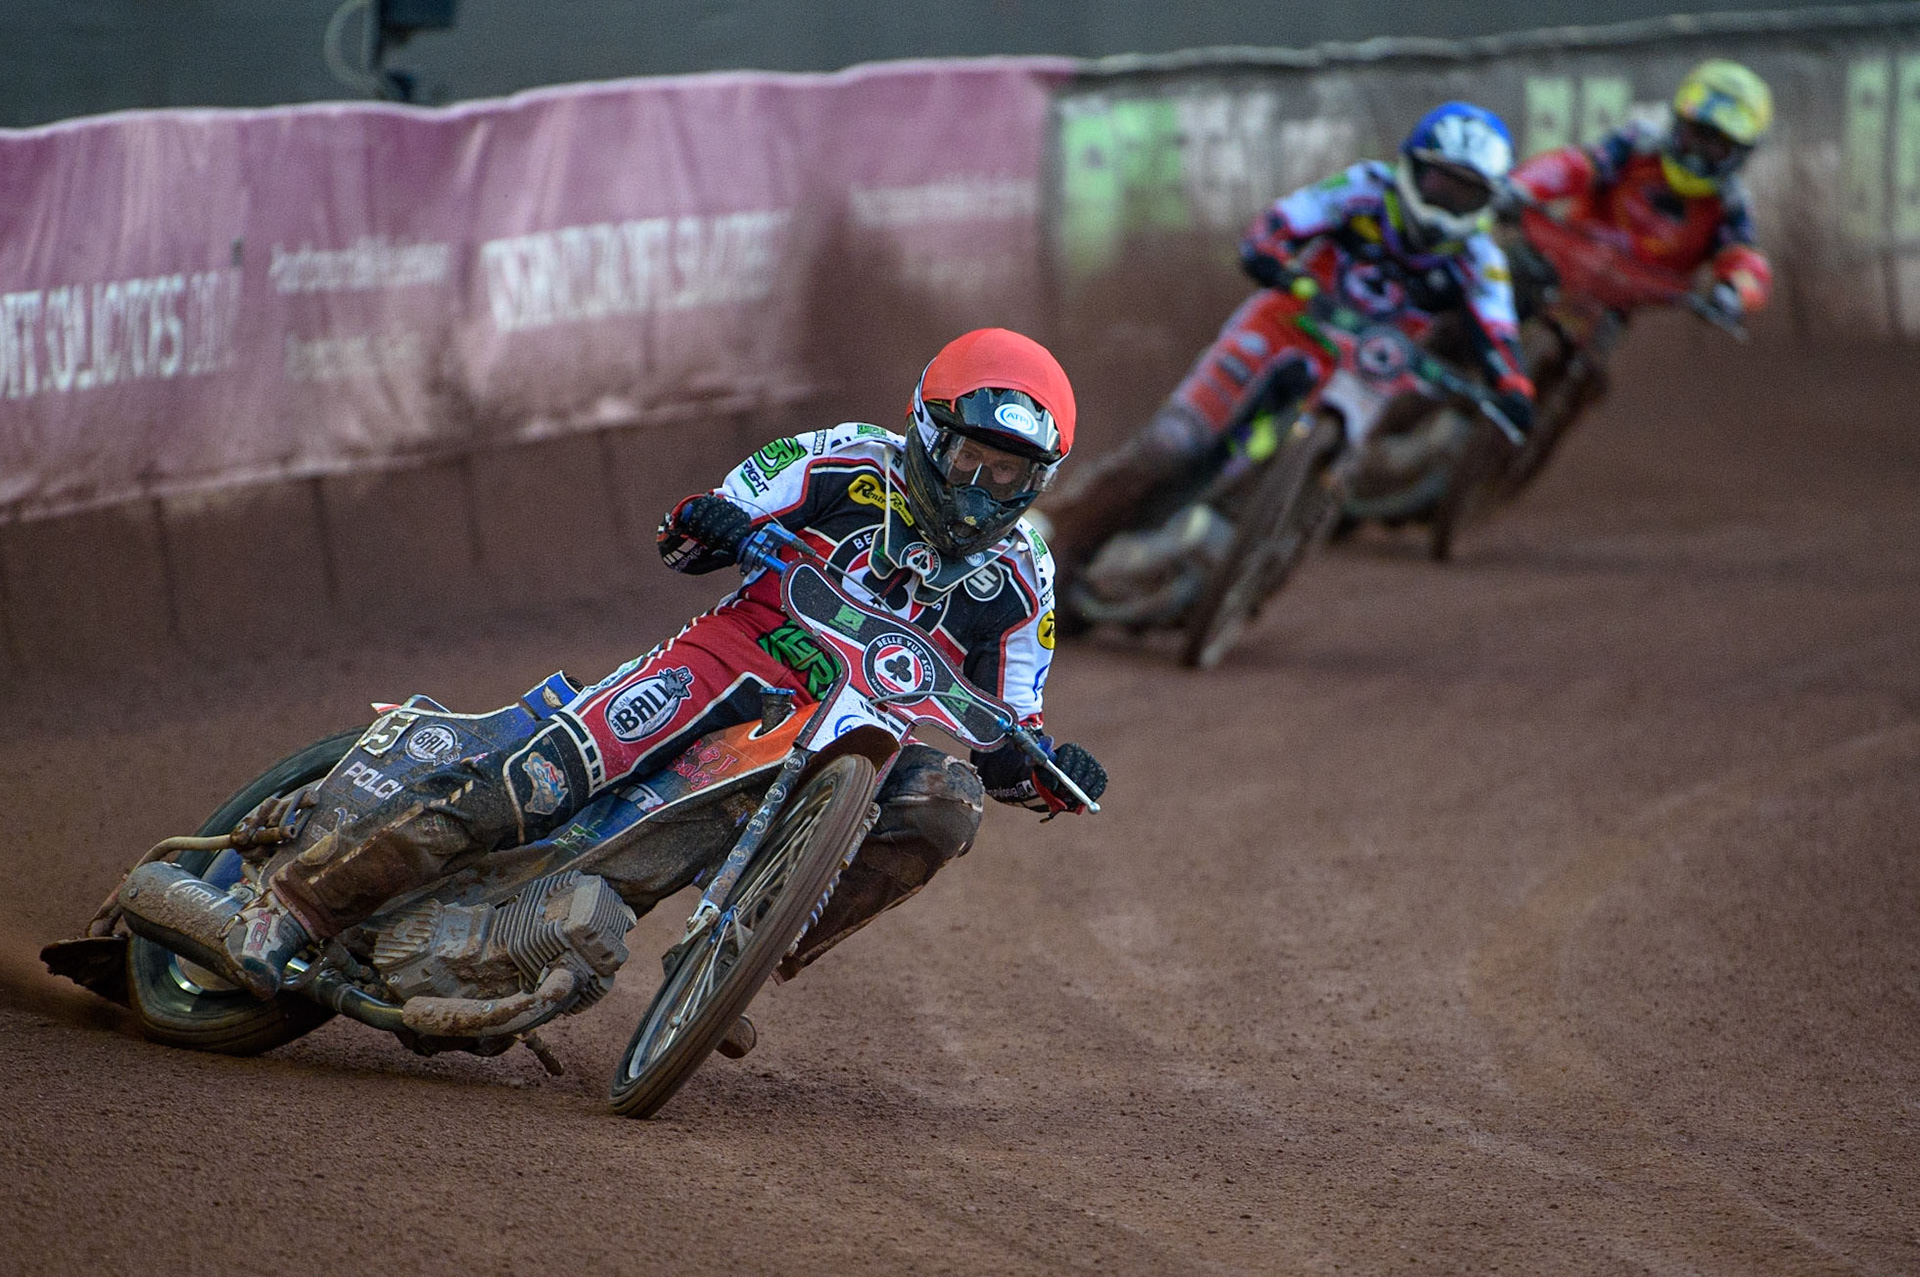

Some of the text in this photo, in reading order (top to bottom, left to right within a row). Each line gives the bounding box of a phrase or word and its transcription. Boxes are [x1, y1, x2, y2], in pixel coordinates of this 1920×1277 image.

[876, 636, 932, 683] BELLE VUE ACES
[614, 682, 673, 734] BALL
